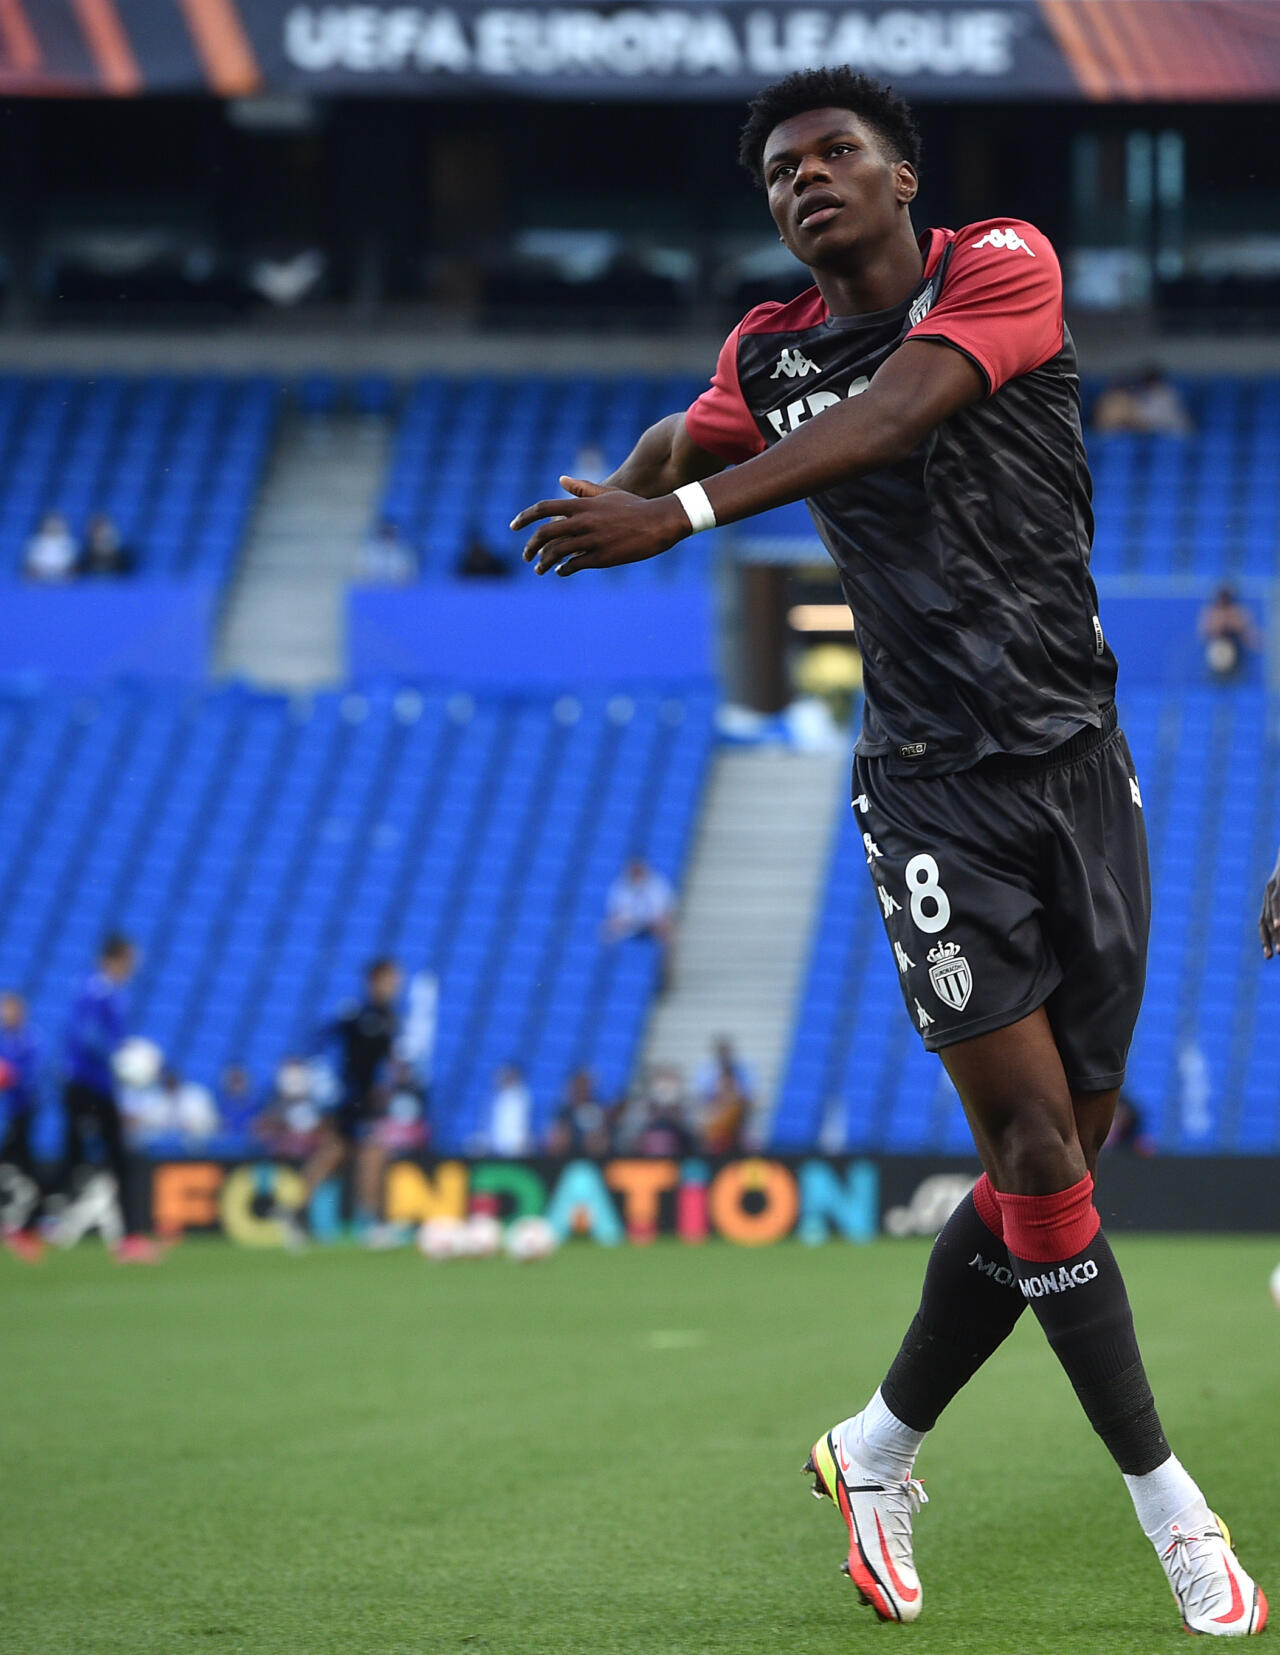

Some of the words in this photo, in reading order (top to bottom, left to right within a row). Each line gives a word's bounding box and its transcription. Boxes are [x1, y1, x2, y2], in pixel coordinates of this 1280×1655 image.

[286, 5, 473, 72] UEFA
[475, 8, 741, 76] EUROPA
[747, 8, 1014, 75] LEAGUE
[905, 853, 951, 934] 8
[1018, 1259, 1099, 1299] MONACO
